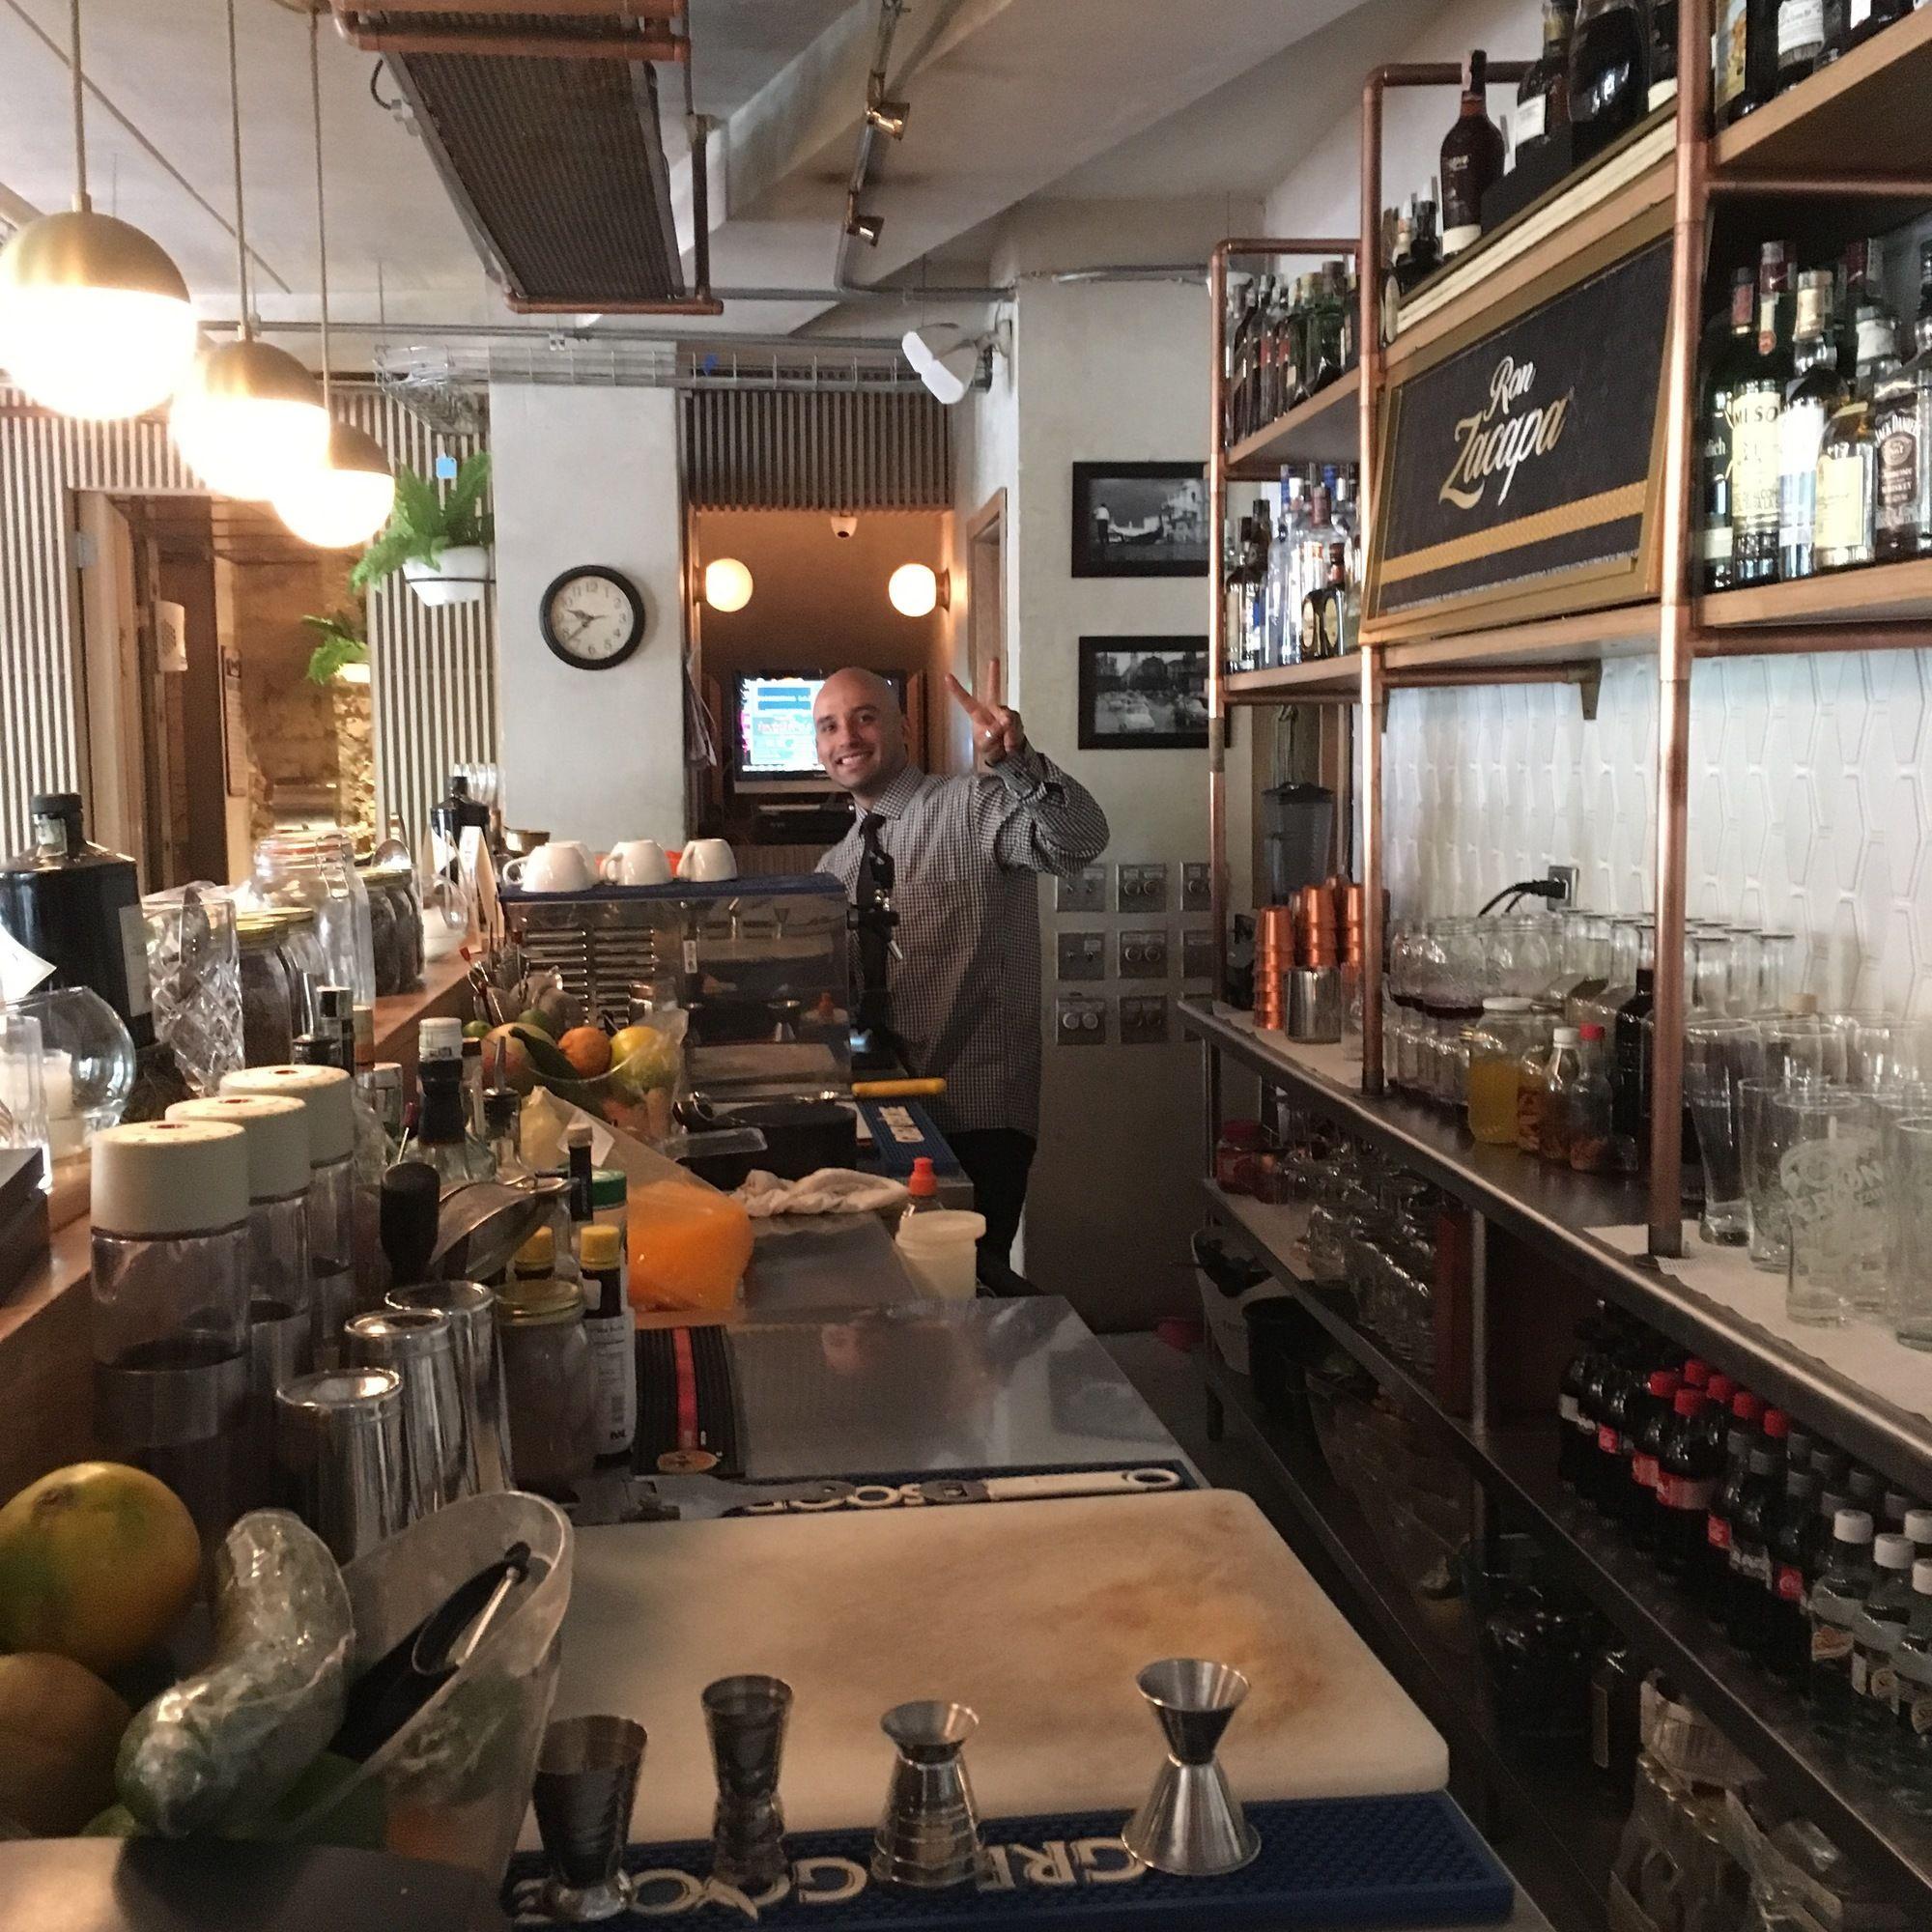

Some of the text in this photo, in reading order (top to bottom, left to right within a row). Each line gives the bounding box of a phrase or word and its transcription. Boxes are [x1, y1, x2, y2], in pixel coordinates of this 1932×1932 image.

[1483, 355, 1537, 421] Ron
[1438, 385, 1575, 510] Zacapa
[585, 581, 598, 593] 12
[978, 1837, 1147, 1892] GRE
